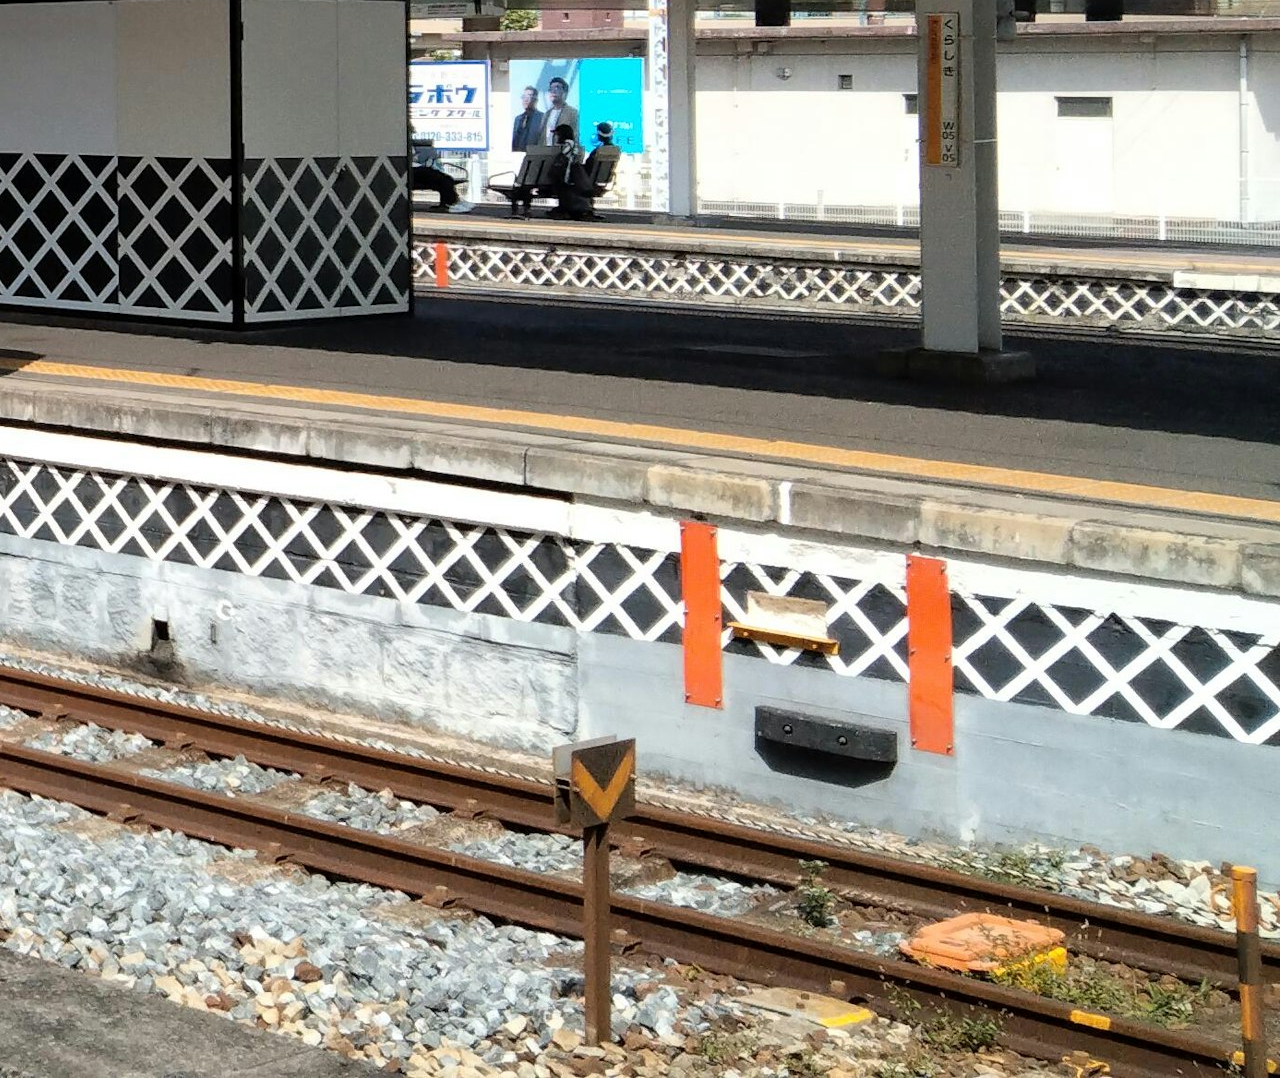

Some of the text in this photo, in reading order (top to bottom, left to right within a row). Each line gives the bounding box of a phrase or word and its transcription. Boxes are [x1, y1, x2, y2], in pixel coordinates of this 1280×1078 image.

[944, 19, 956, 77] くらしき
[943, 122, 955, 130] W
[942, 131, 955, 140] 05
[945, 144, 953, 152] V
[942, 153, 955, 162] 05
